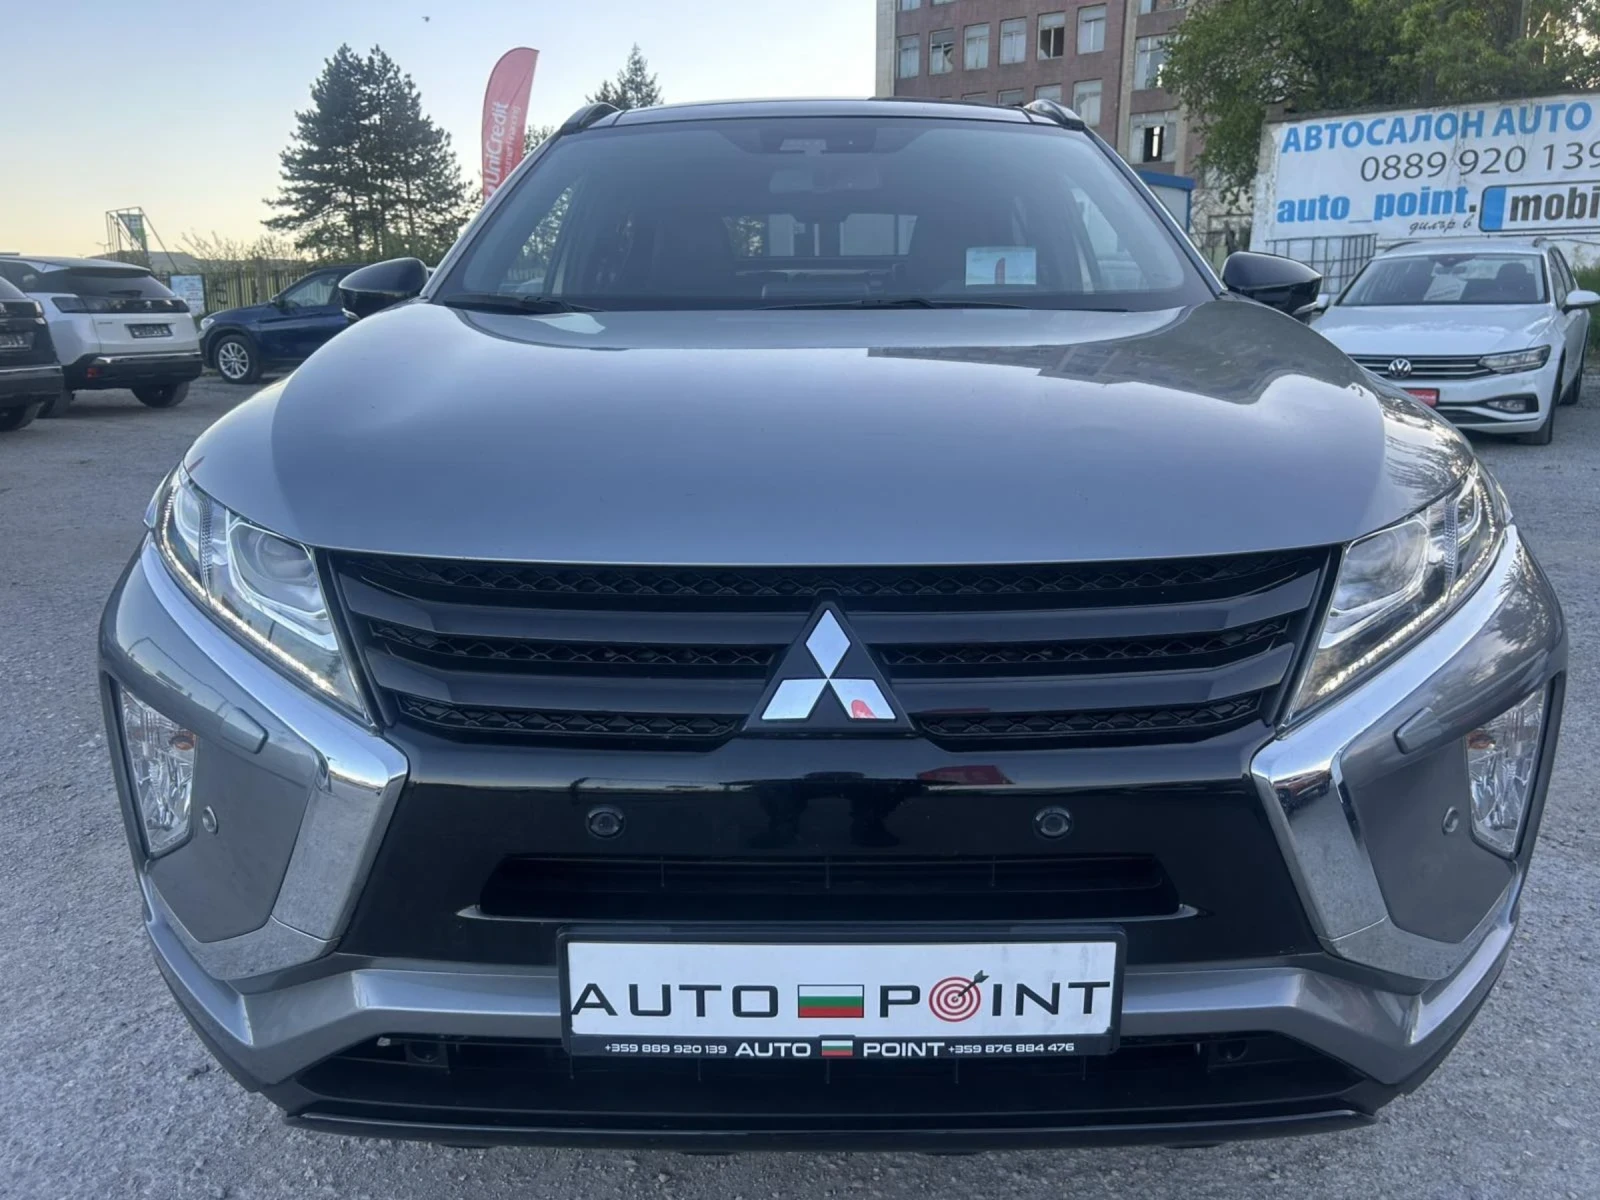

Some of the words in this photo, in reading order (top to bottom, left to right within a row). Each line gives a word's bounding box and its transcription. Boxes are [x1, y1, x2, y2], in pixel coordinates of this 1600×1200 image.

[485, 101, 509, 186] UniCredit
[1281, 110, 1485, 154] АВТОСАЛОН
[1492, 102, 1593, 137] AUTO
[1360, 151, 1447, 182] 0889
[1459, 145, 1527, 176] 920
[571, 983, 779, 1018] AUTO
[604, 1043, 638, 1053] +359
[642, 1044, 670, 1053] 889
[674, 1044, 702, 1053] 920
[705, 1044, 728, 1054] 139
[735, 1042, 812, 1057] AUTO
[863, 1042, 945, 1057] POINT
[948, 1044, 982, 1053] +359
[985, 1044, 1012, 1053] 876
[1015, 1043, 1044, 1053] 884
[1047, 1042, 1075, 1052] 476
